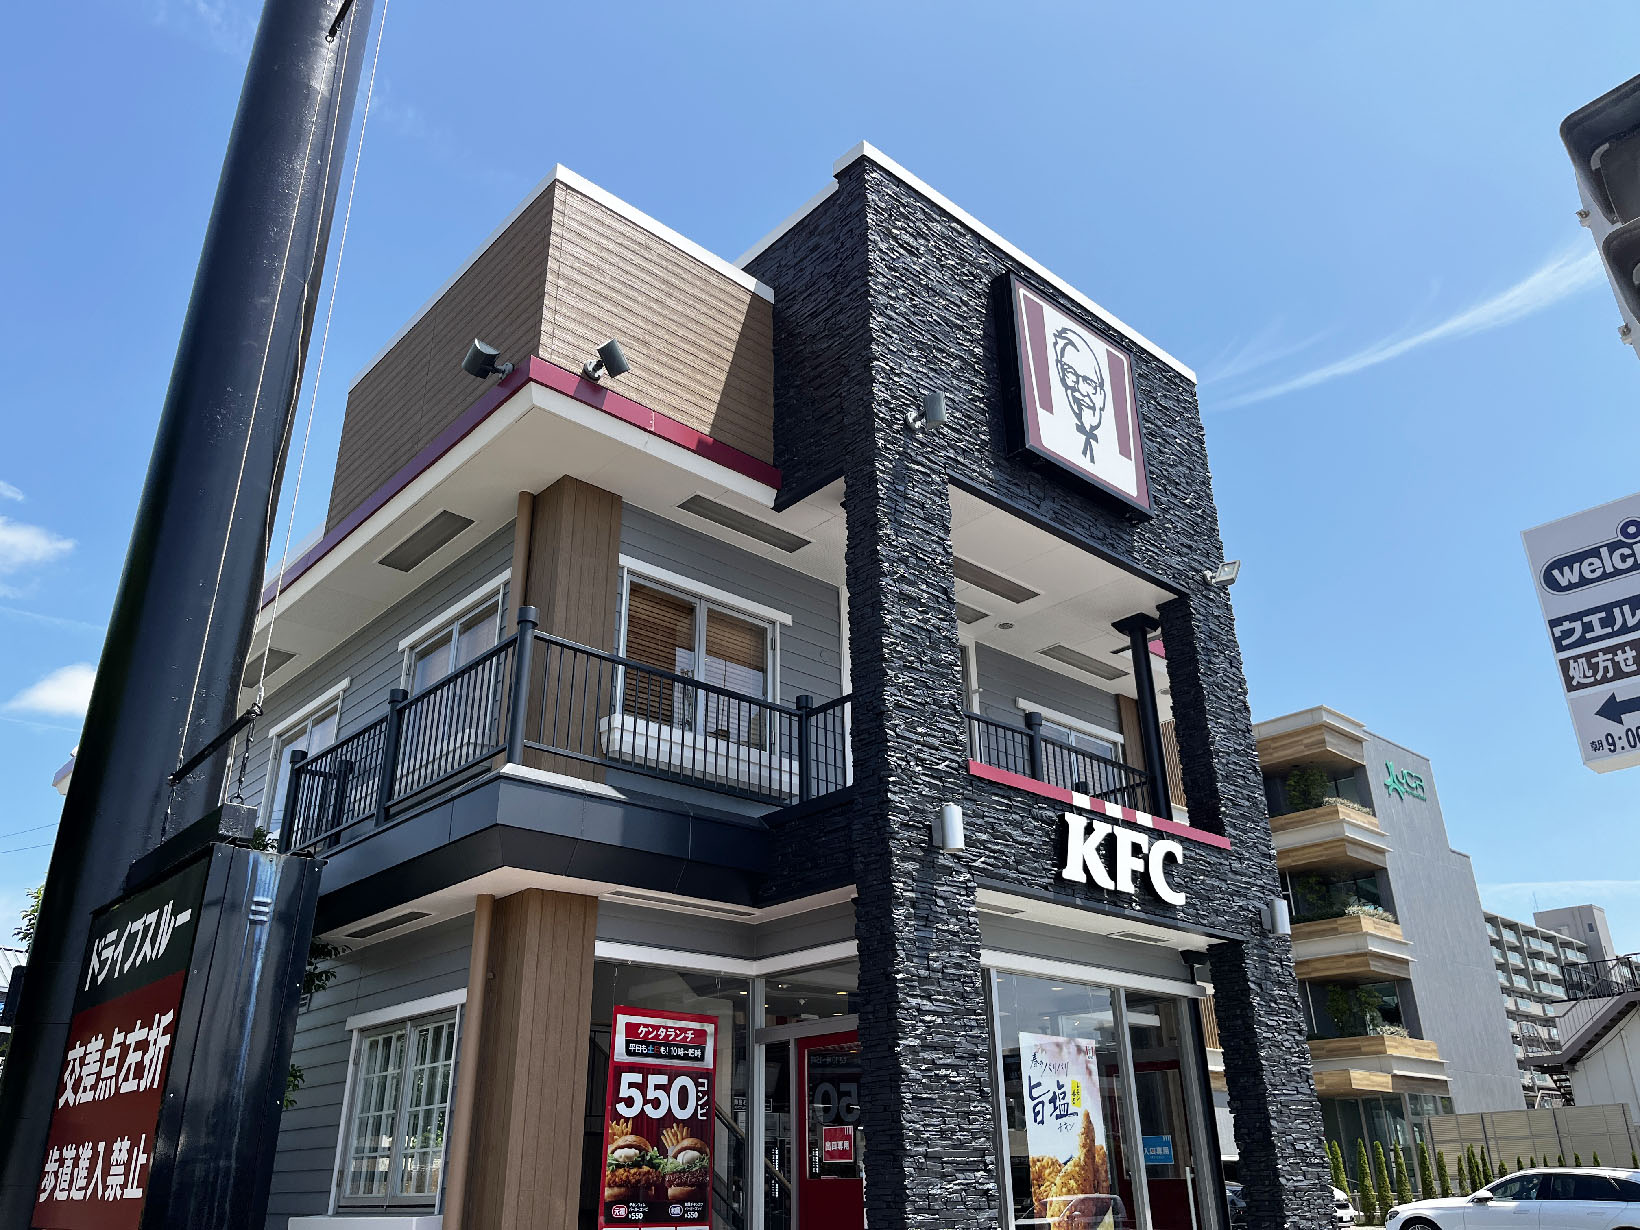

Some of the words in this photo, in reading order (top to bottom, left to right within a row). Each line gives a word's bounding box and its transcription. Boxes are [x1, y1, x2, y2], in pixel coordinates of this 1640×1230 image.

[1568, 645, 1638, 685] 処方せ
[1062, 811, 1186, 906] KFC
[84, 900, 192, 991] ドライブスルー
[637, 1025, 695, 1042] ケンタランチ
[58, 1009, 174, 1109] 交差点左折
[615, 1073, 697, 1120] 550
[697, 1078, 708, 1120] コンビ
[1028, 1075, 1079, 1125] 旨塩
[39, 1133, 148, 1202] 歩道進入禁止
